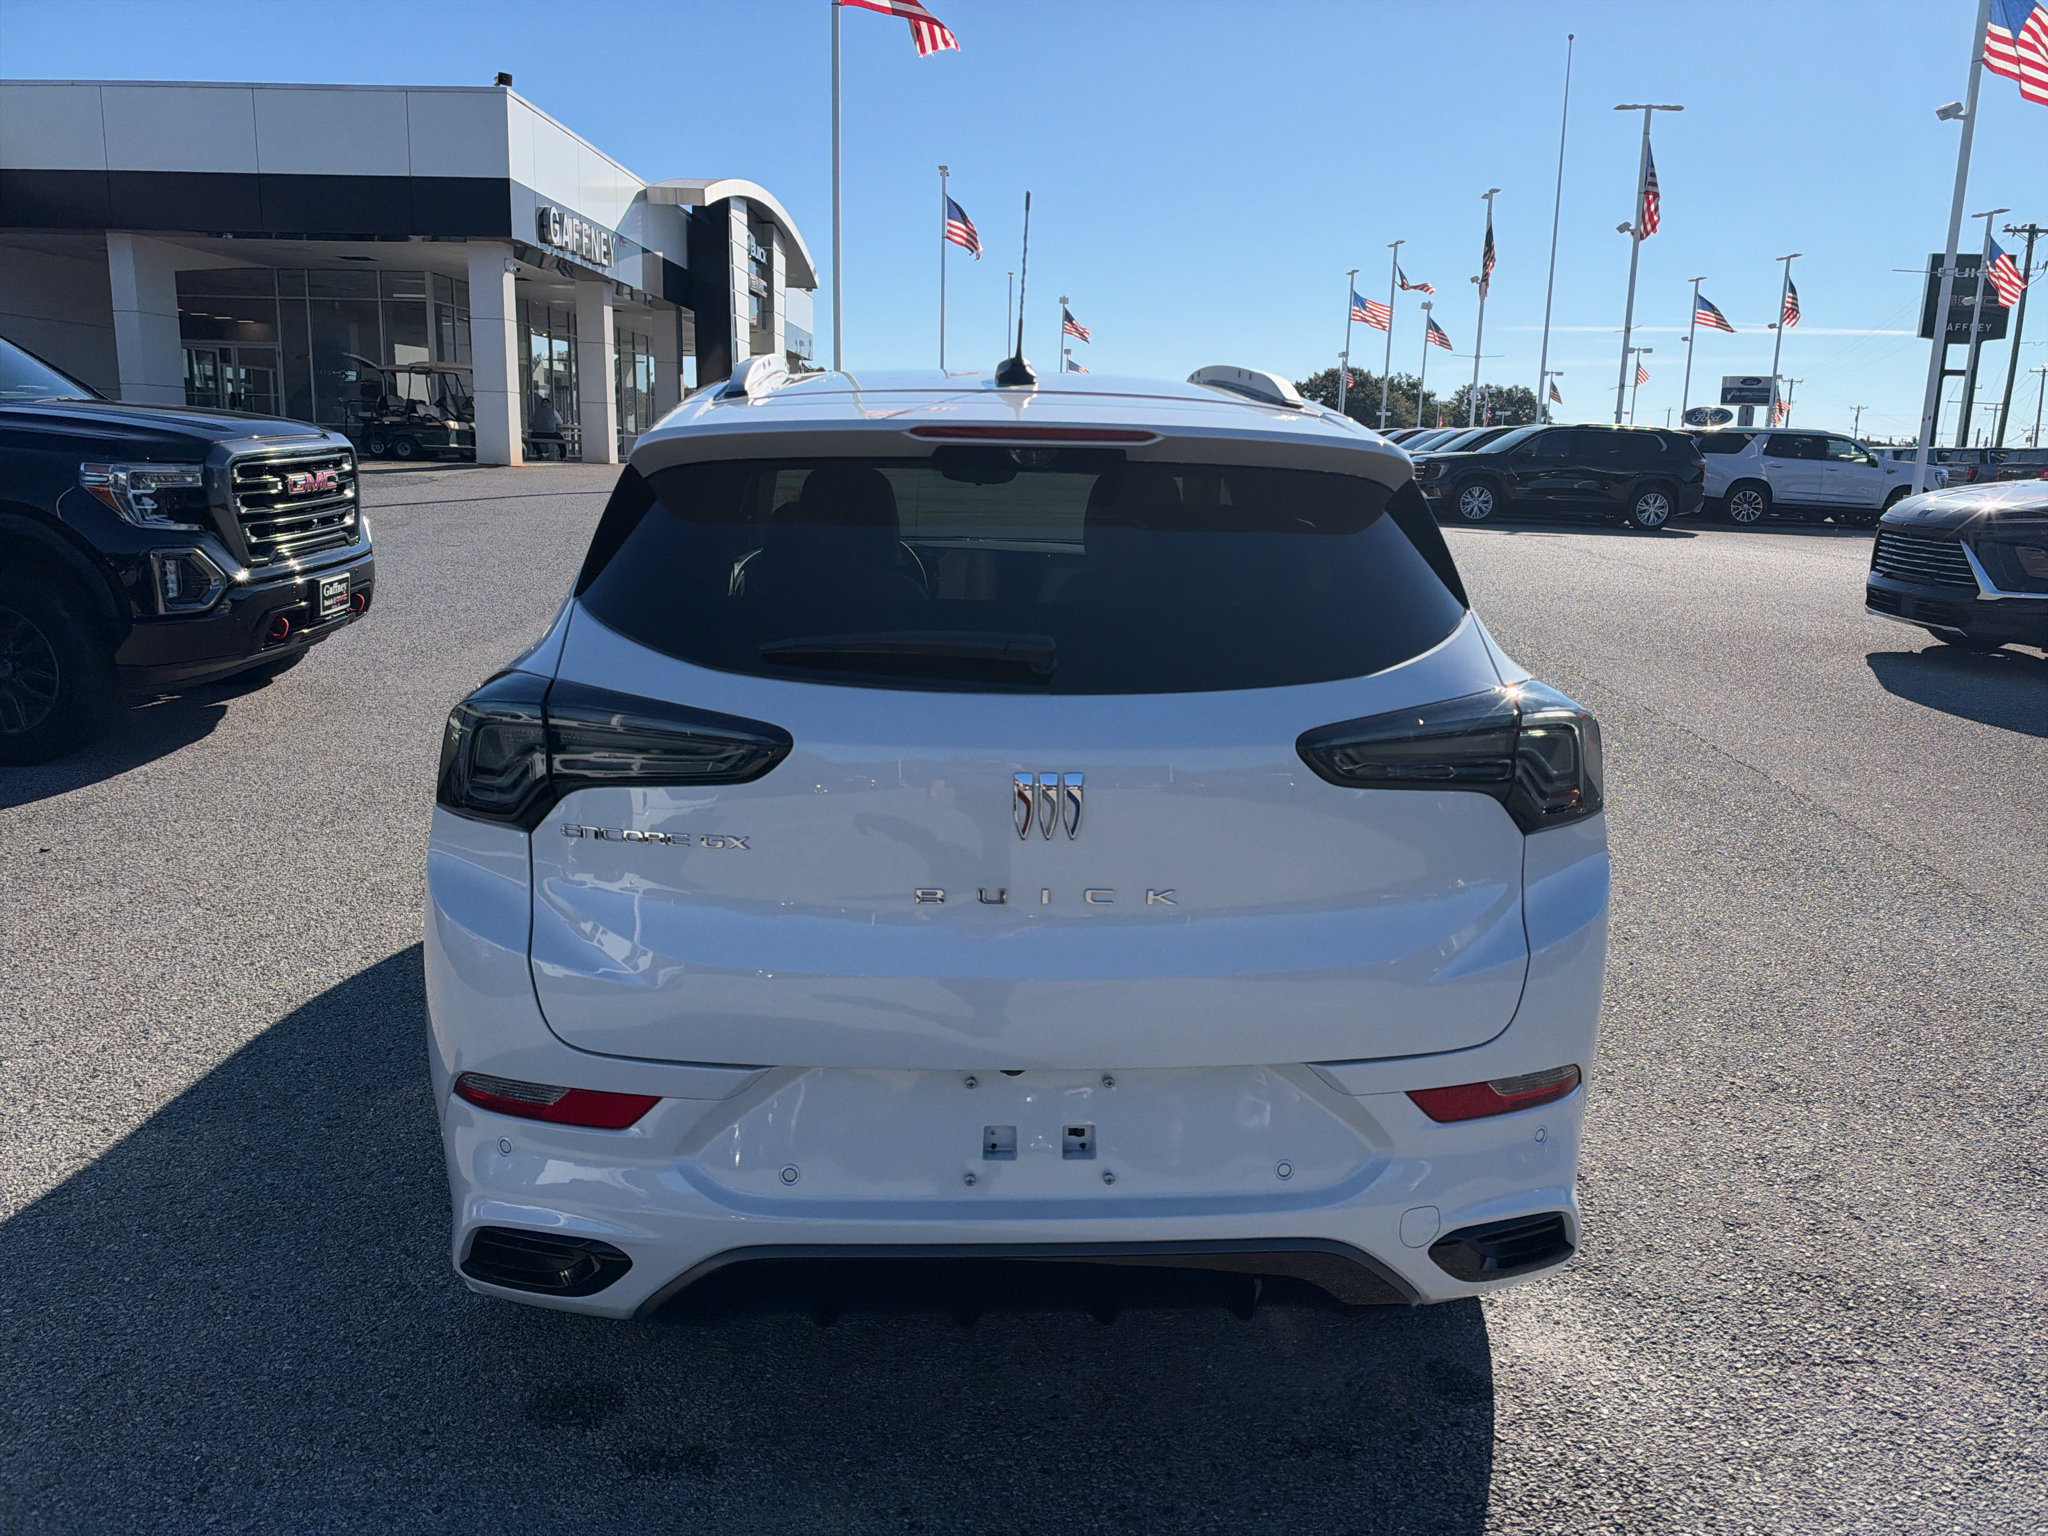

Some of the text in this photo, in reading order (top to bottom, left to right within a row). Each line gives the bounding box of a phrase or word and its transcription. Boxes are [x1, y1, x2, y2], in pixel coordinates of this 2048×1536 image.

[549, 206, 616, 268] GAFFNEY
[1946, 323, 1992, 332] AFFEY
[288, 470, 337, 494] GMC
[560, 823, 751, 850] ENCORE GX
[915, 888, 1178, 905] BUICK
